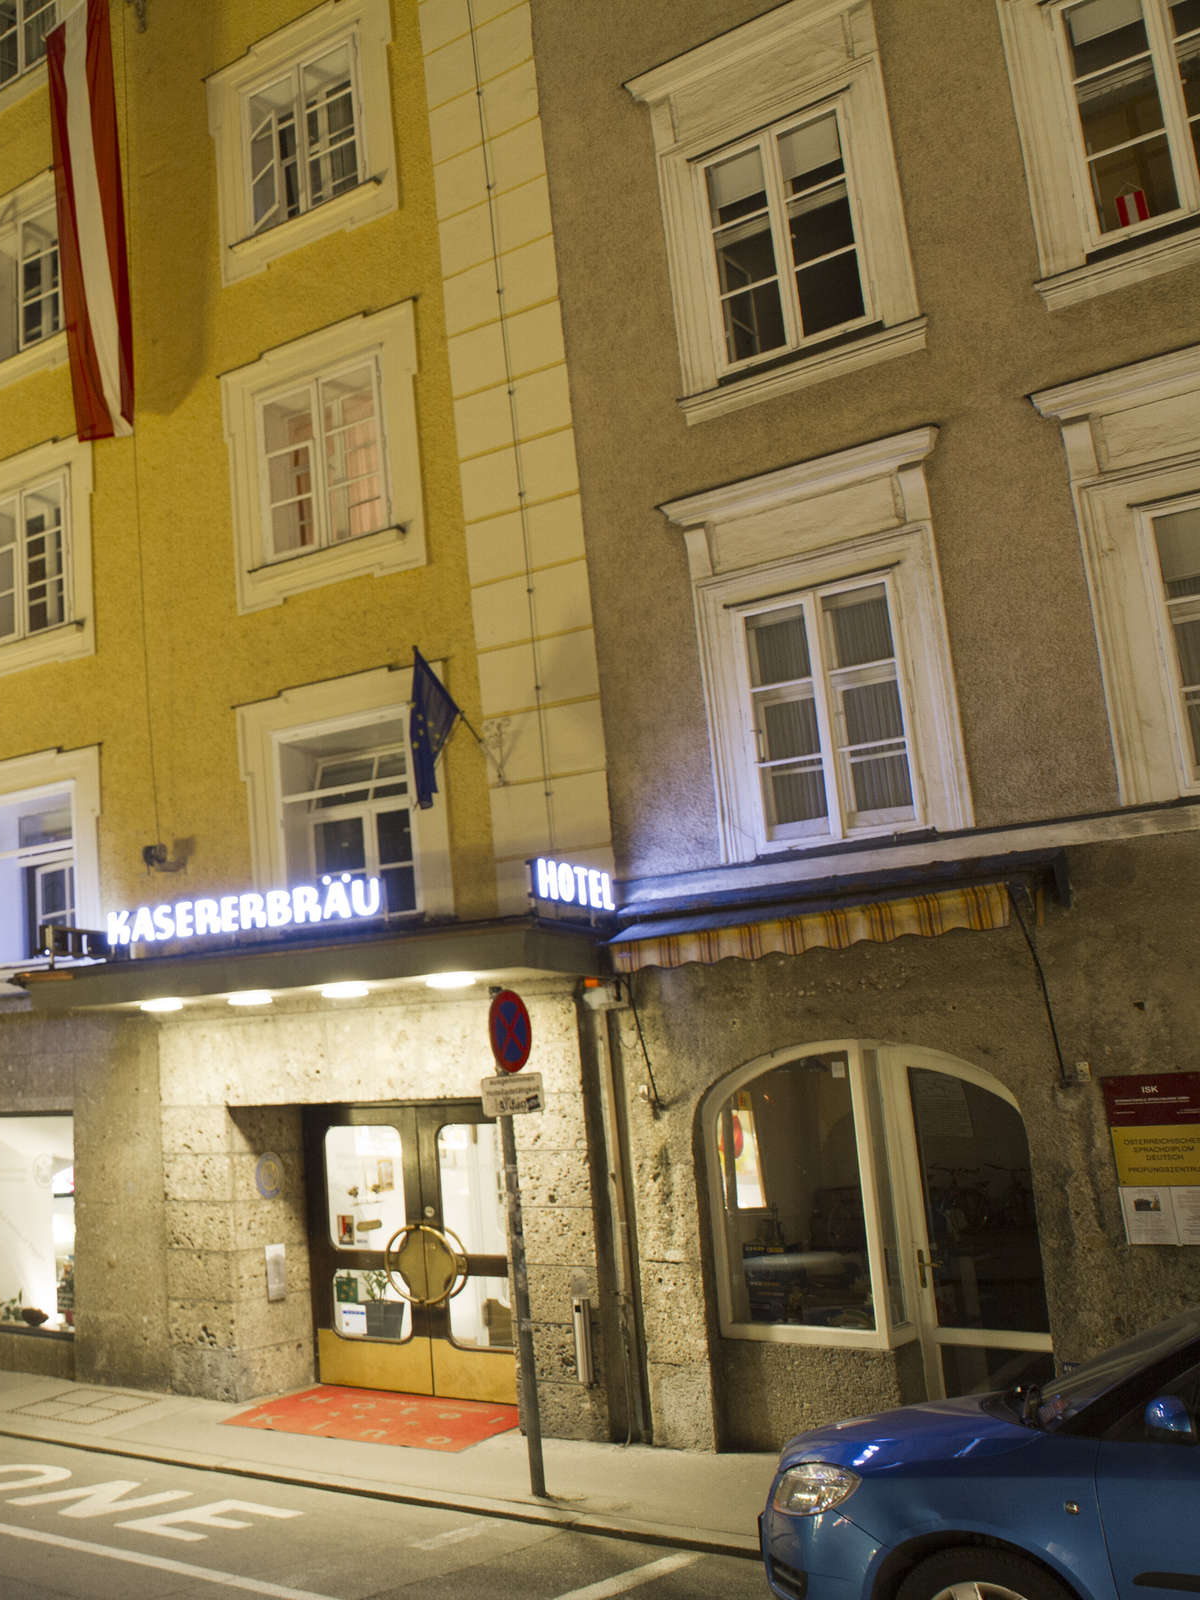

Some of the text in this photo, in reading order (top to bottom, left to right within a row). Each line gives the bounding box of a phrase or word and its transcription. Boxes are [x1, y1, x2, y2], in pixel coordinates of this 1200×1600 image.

[536, 857, 616, 911] HOTEL
[106, 872, 381, 945] KASERERBRÄU
[1141, 1086, 1159, 1094] ISK
[1146, 1153, 1184, 1161] DEUTSCH
[1128, 1166, 1200, 1174] PRÜFUNGSZENTRU
